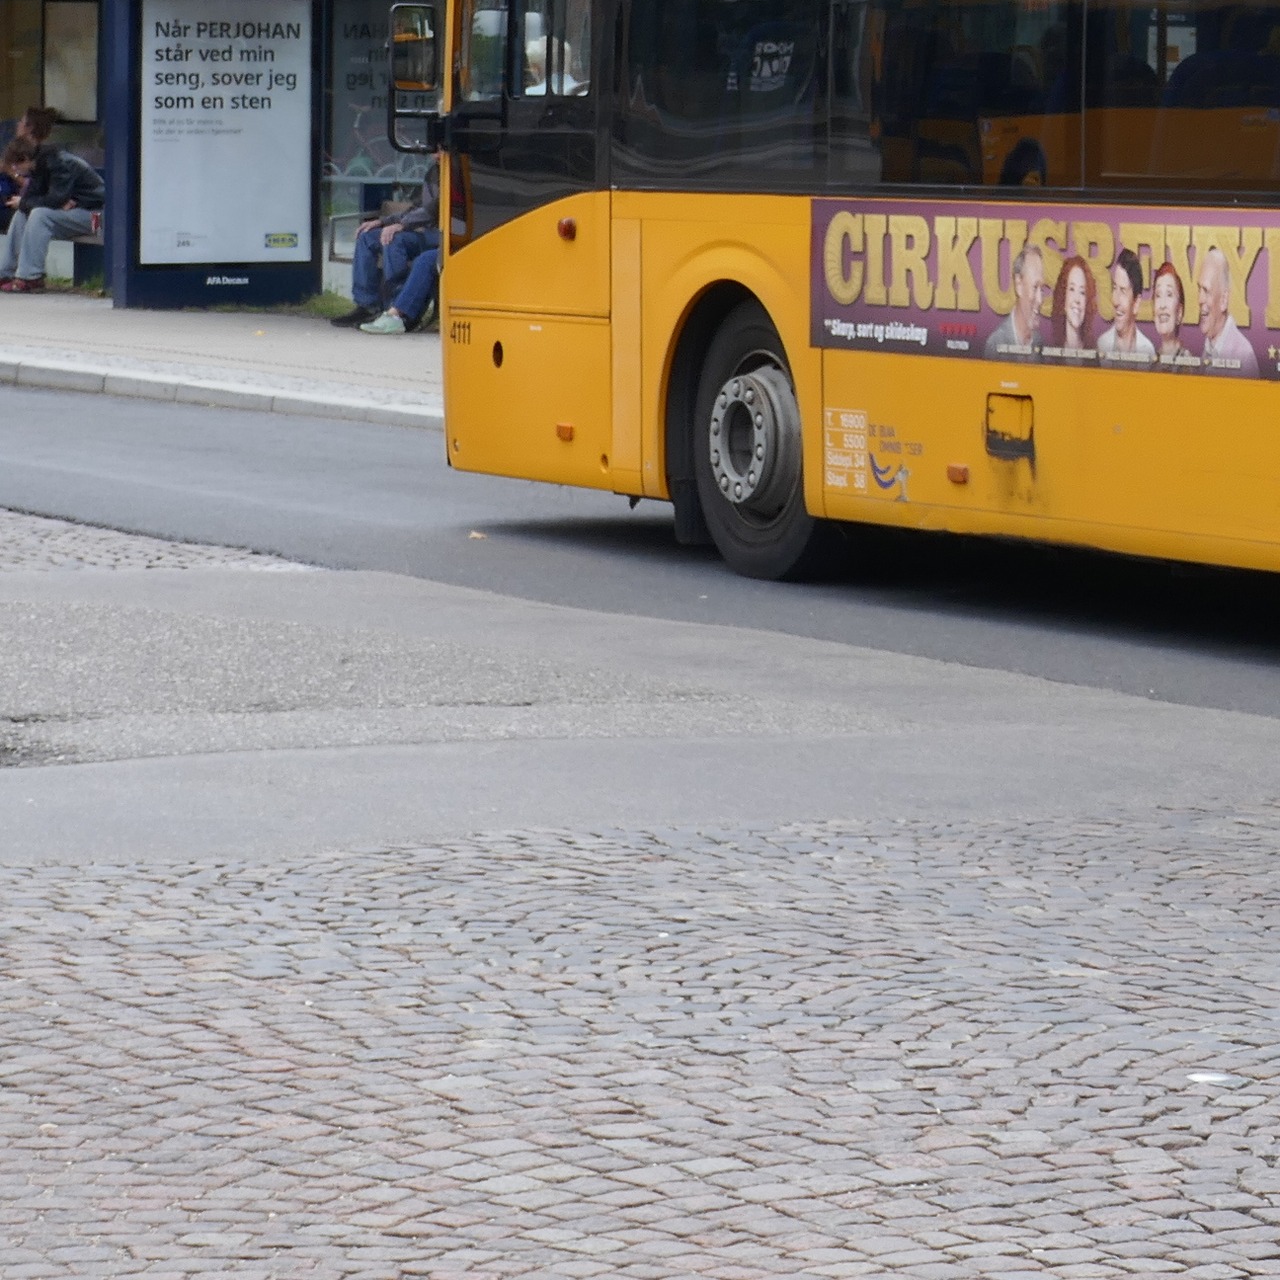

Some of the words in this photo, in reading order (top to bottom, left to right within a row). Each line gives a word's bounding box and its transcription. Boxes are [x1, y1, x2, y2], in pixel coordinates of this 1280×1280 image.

[155, 19, 190, 38] Når
[196, 22, 300, 39] PERJOHAN
[155, 43, 193, 62] står
[199, 45, 232, 62] ved
[239, 45, 275, 62] min
[155, 72, 205, 91] seng,
[211, 72, 263, 87] sover
[267, 69, 297, 91] jeg
[154, 96, 194, 110] som
[201, 96, 224, 110] en
[230, 94, 272, 110] sten
[450, 321, 471, 345] 4111
